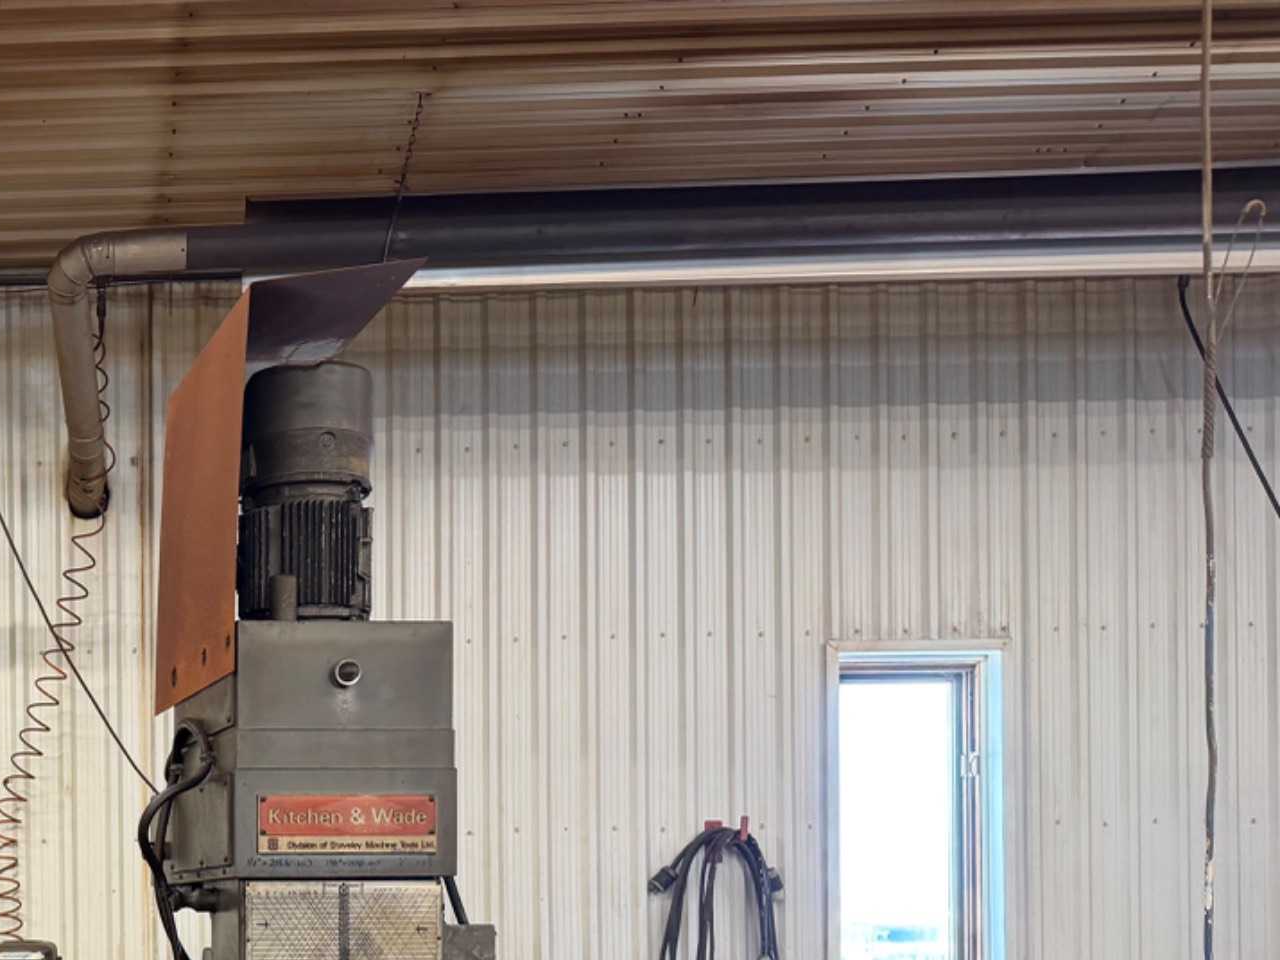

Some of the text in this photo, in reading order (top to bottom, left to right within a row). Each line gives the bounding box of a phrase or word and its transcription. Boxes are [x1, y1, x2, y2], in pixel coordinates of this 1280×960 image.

[268, 806, 428, 825] Kitchen & Wade
[320, 841, 328, 850] of
